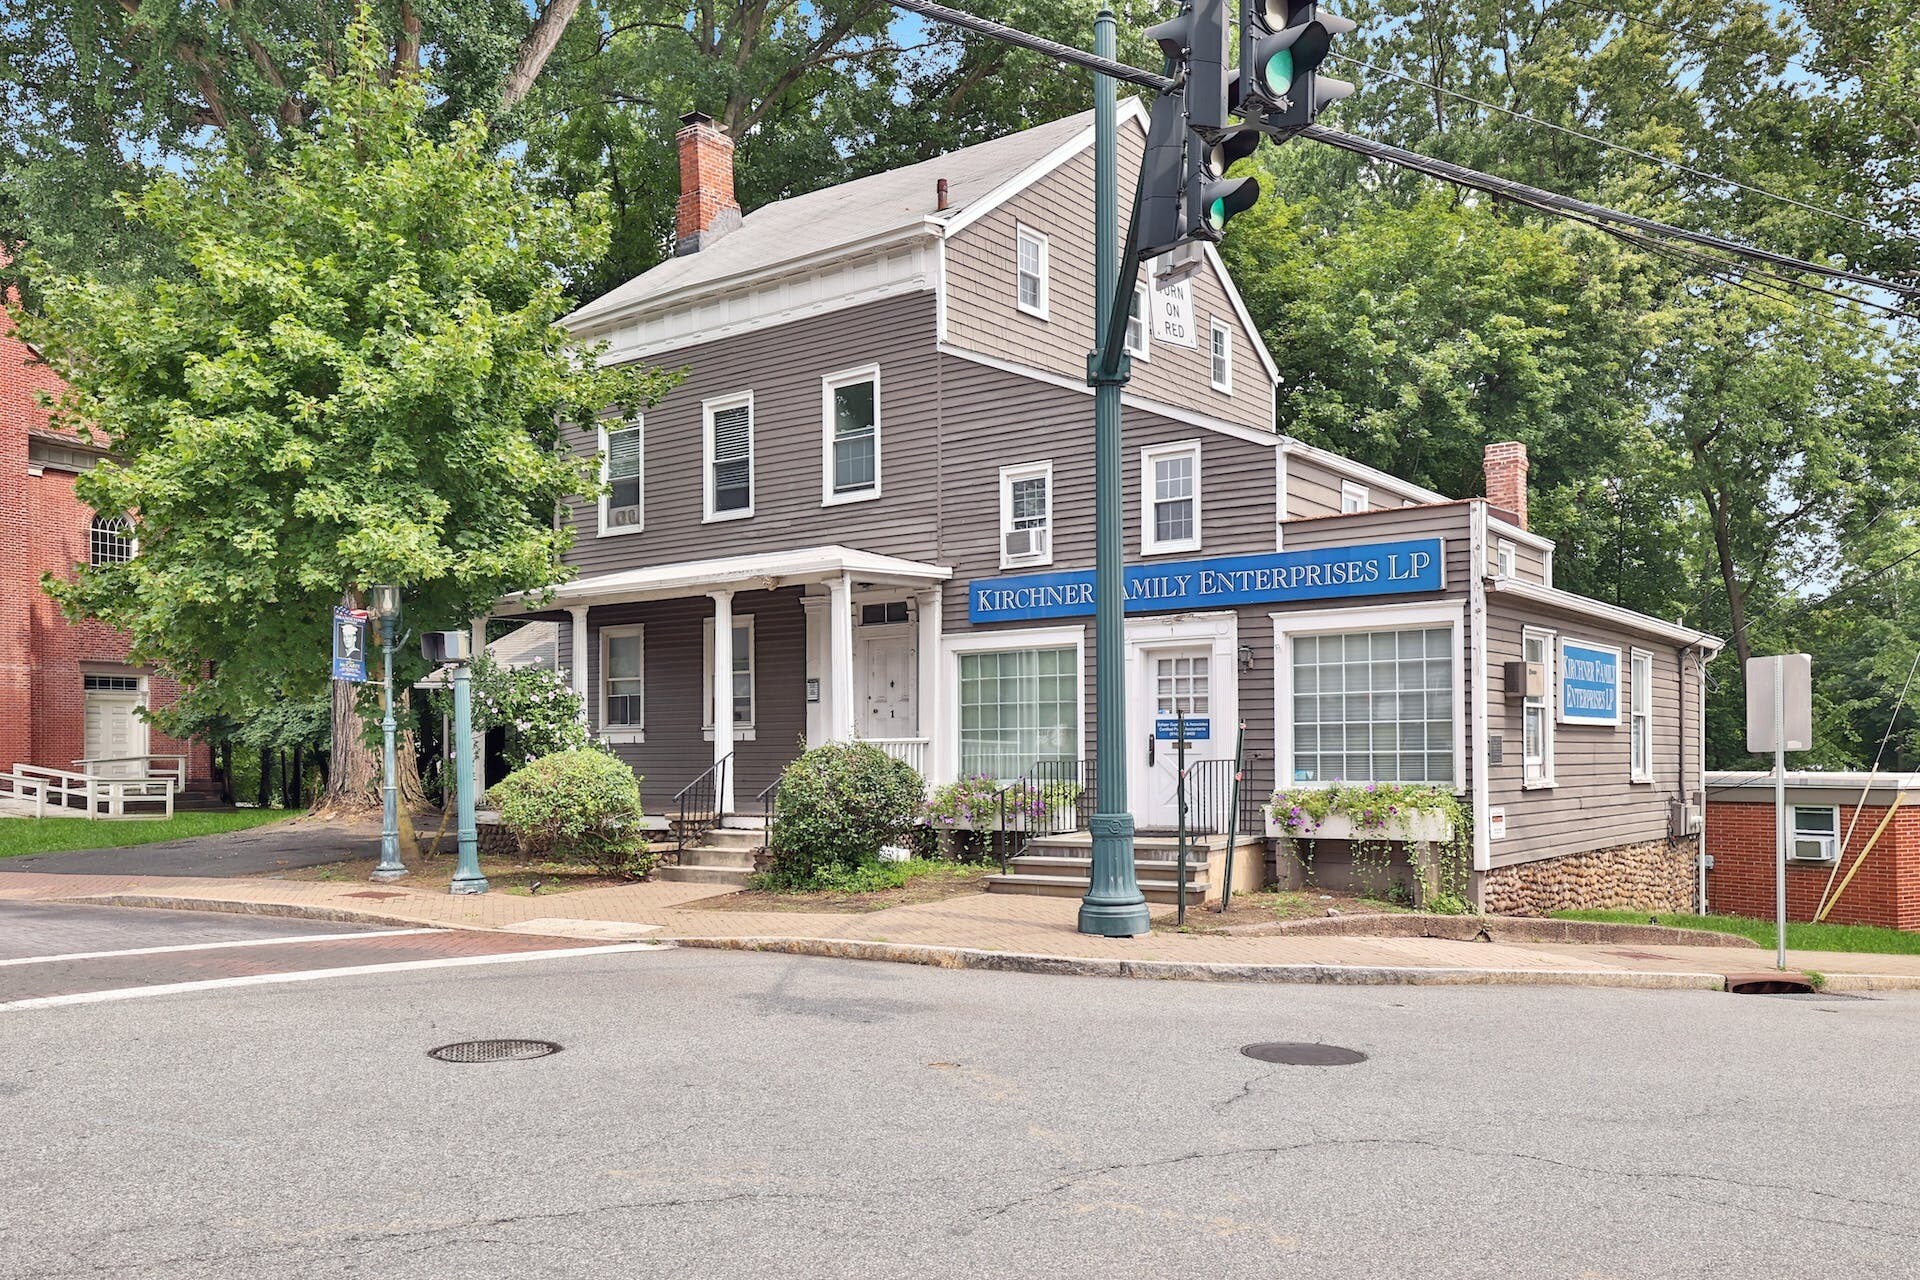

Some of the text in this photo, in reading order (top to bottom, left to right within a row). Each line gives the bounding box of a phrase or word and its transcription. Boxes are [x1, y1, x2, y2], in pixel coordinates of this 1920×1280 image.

[1160, 285, 1184, 300] URN
[1166, 302, 1180, 318] ON
[1165, 321, 1185, 338] RED
[977, 552, 1430, 612] KIRCHNER AMILY ENTERPRISES LP
[1563, 655, 1595, 682] KIRCHNER
[1567, 684, 1614, 710] ENTERPRISES LP
[890, 709, 895, 718] 1
